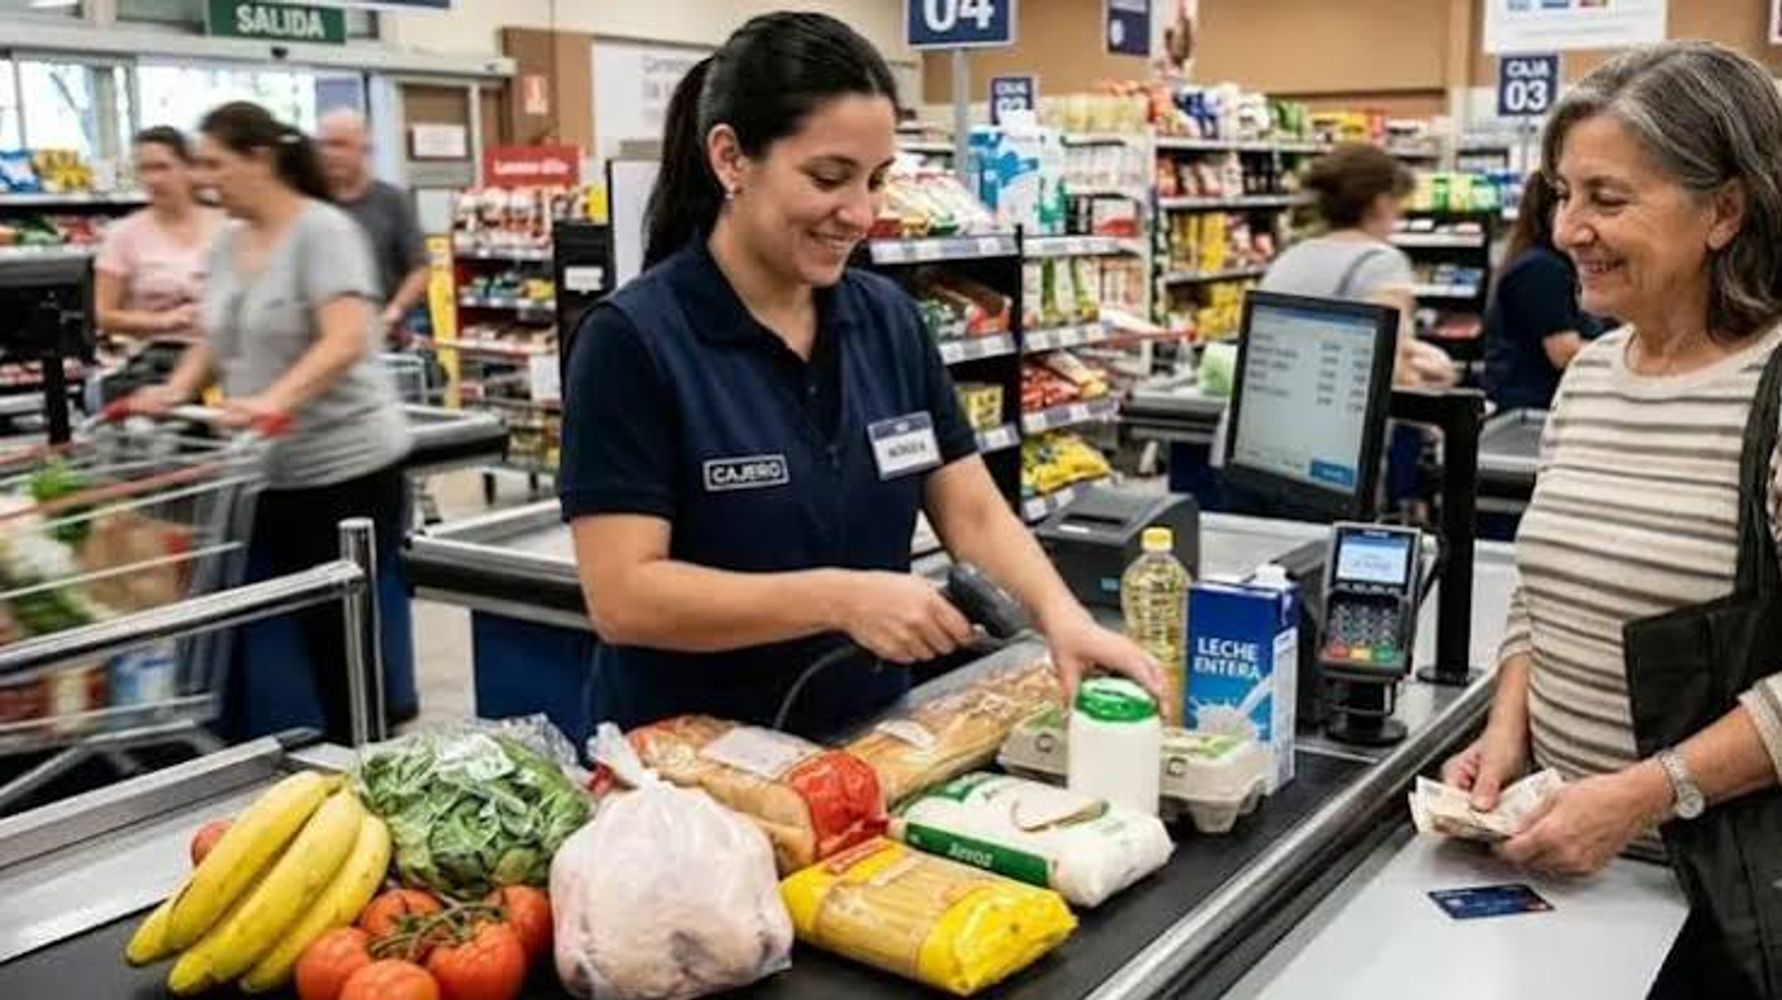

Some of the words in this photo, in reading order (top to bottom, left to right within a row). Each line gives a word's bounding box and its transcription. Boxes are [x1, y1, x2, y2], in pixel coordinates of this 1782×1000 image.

[236, 4, 325, 38] SALIDA
[924, 0, 994, 32] 04
[1506, 60, 1549, 77] CAJA
[1505, 80, 1548, 111] 03
[712, 462, 781, 483] CAJERO
[1197, 637, 1260, 661] LECHE
[1193, 656, 1262, 679] ENTERA
